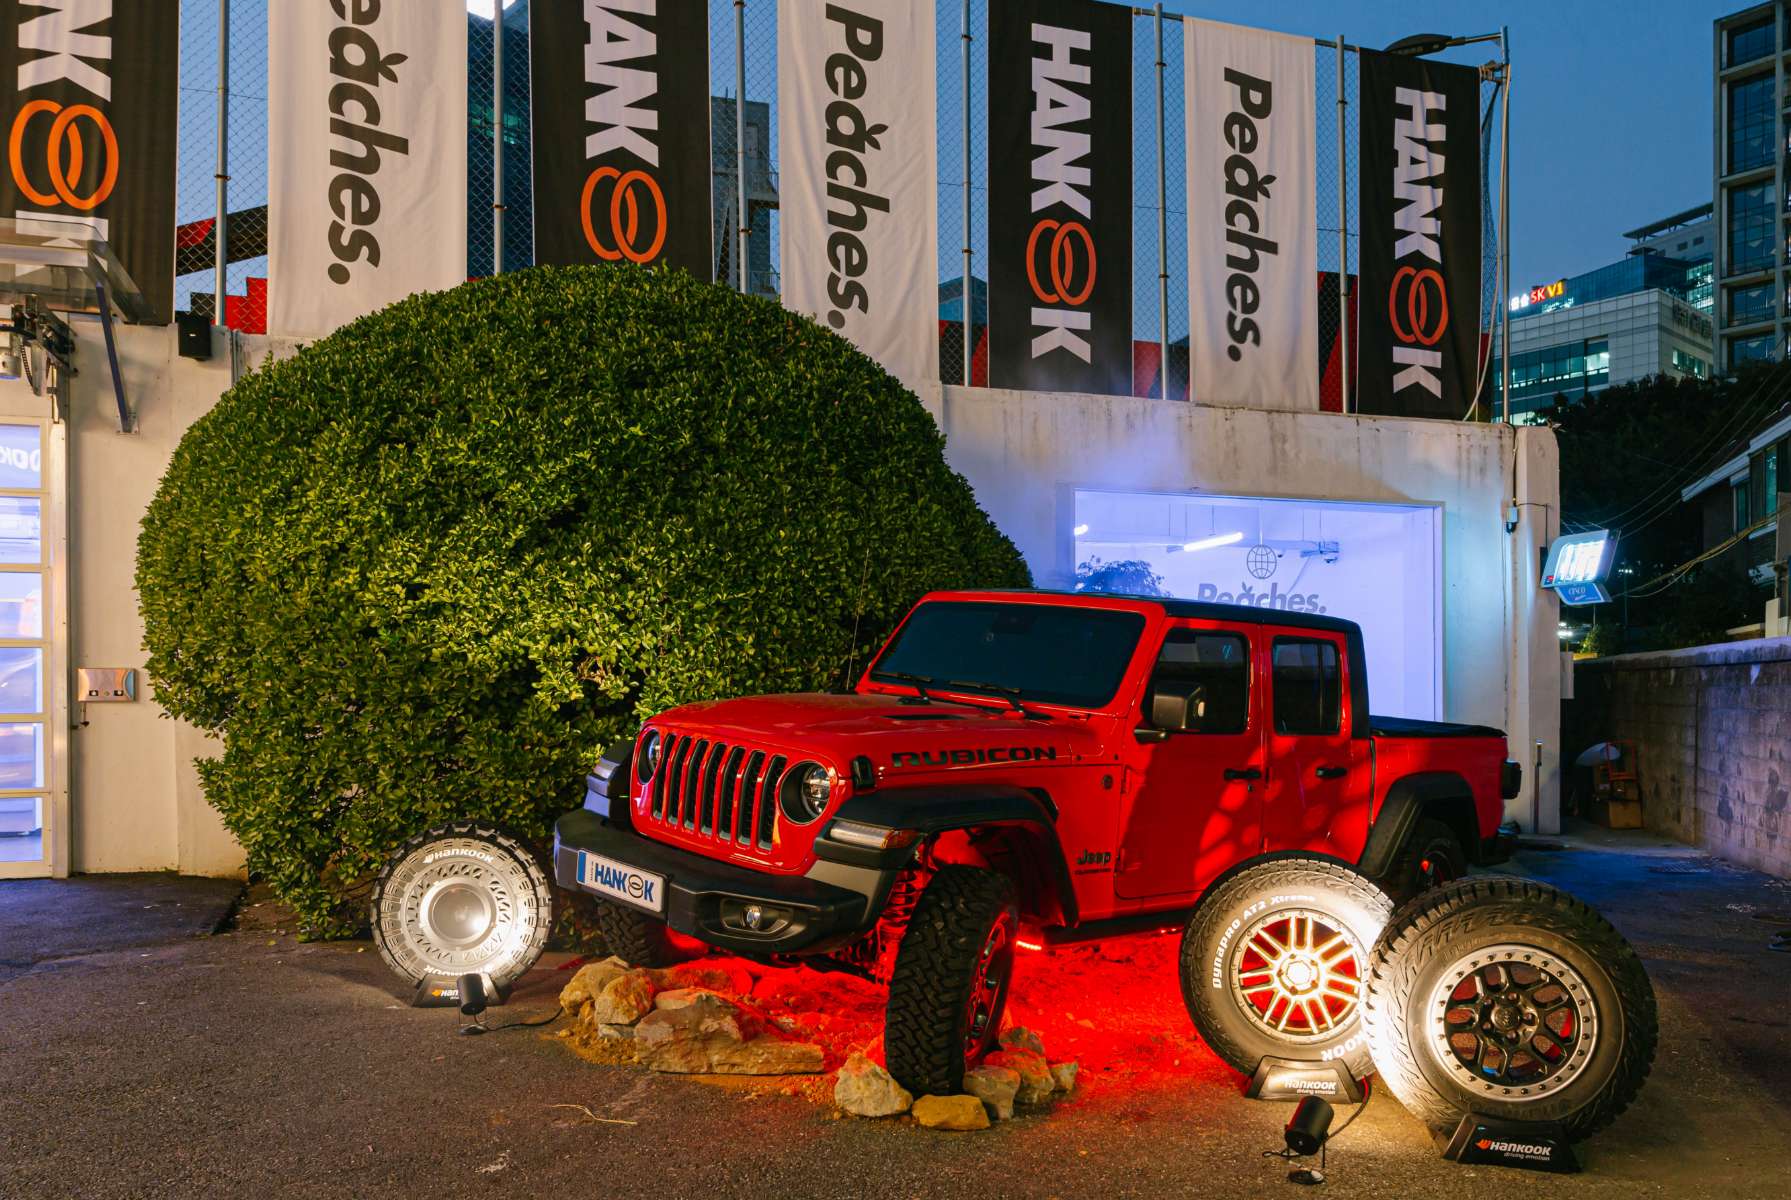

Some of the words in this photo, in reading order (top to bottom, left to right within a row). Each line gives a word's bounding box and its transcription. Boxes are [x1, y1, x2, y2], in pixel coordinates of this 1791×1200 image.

[825, 3, 890, 329] Peaches.
[1223, 66, 1278, 362] Peaches.
[1530, 287, 1546, 304] SK
[891, 747, 1057, 767] RUBICON
[1077, 848, 1112, 865] Jeep
[1243, 901, 1266, 920] AT2
